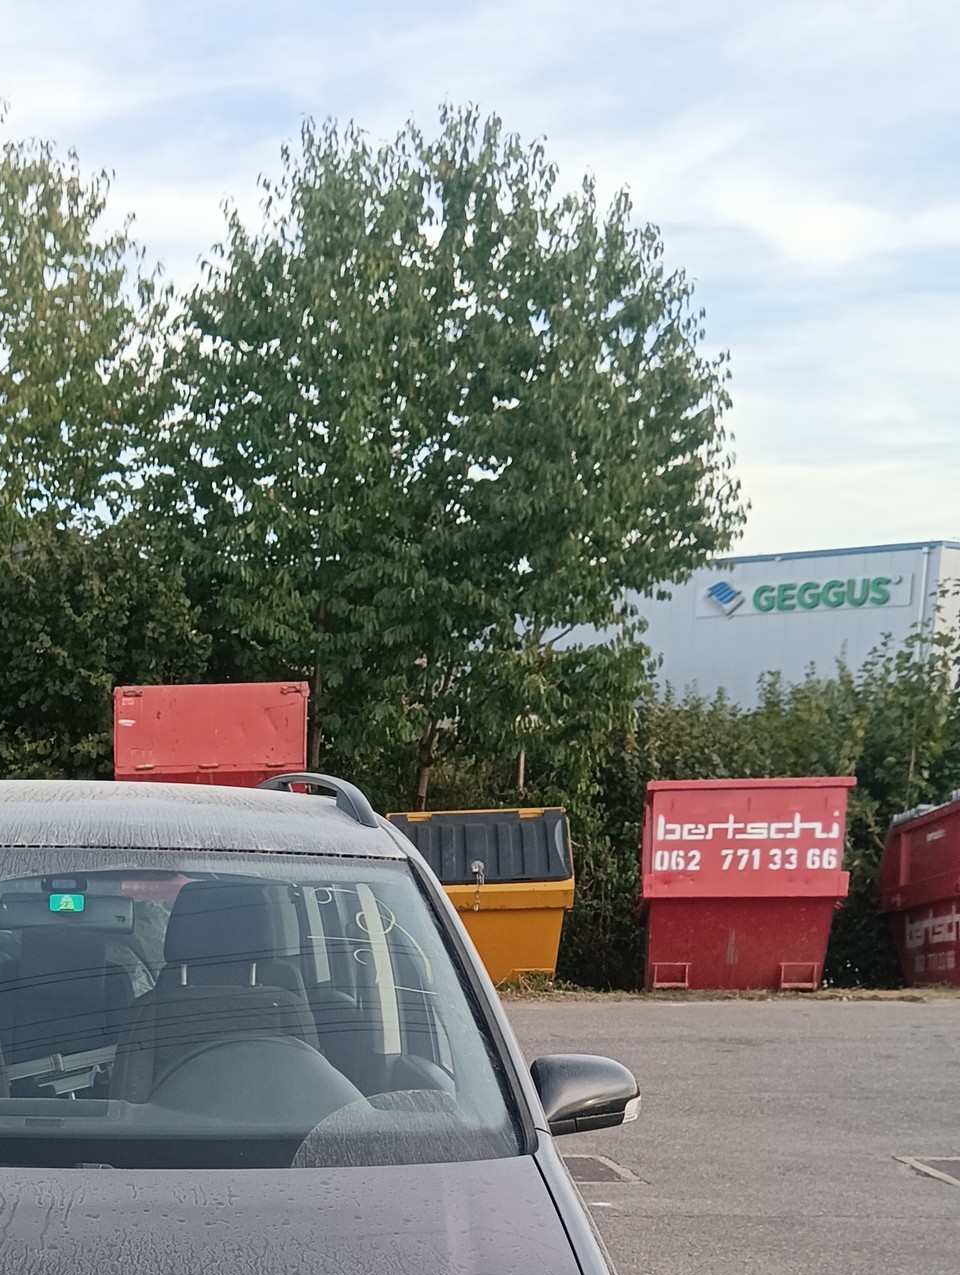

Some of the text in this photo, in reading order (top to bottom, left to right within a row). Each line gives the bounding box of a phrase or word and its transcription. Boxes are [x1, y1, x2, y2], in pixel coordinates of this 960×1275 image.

[753, 576, 890, 612] GEGGUS
[656, 810, 840, 841] bertschi
[654, 848, 838, 871] 062 771 33 66
